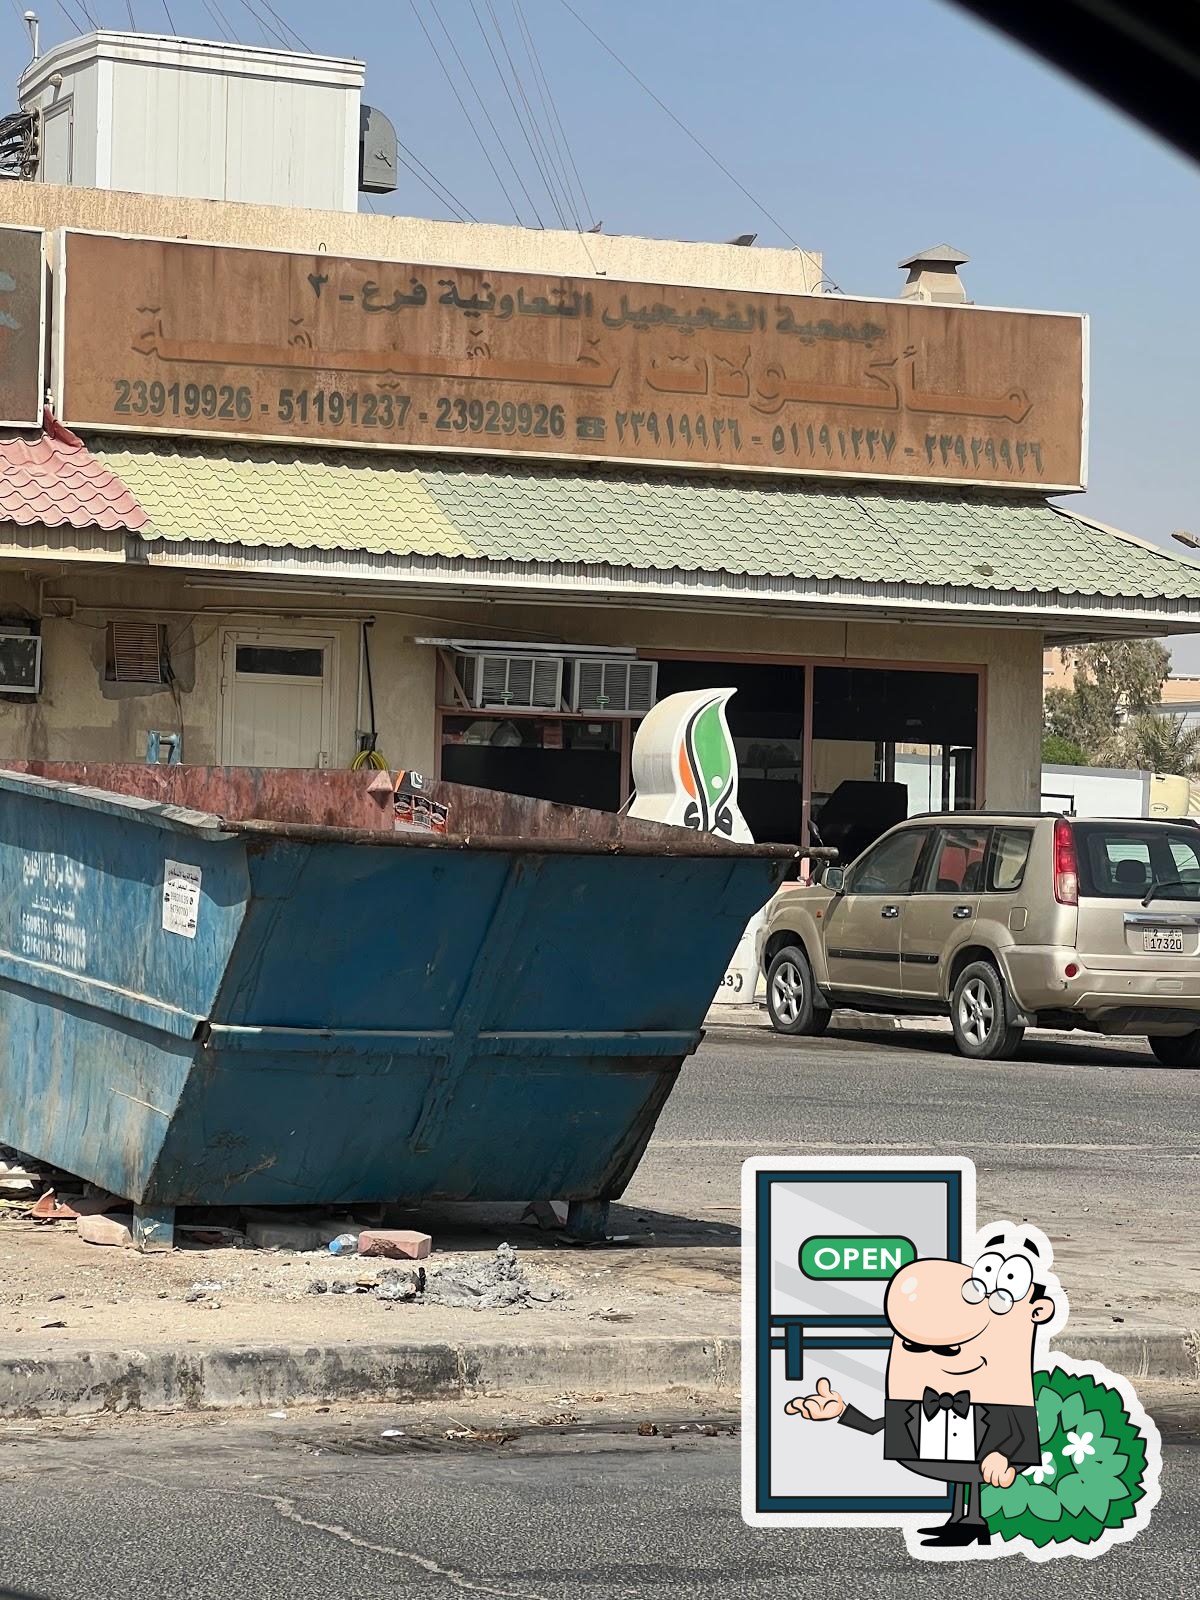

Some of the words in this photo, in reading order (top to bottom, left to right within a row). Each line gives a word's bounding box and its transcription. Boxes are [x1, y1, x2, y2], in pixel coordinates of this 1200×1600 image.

[361, 277, 428, 313] فرع
[437, 279, 594, 320] التعاونية
[776, 304, 886, 348] جمعية
[114, 379, 252, 421] 23919926
[278, 388, 412, 429] 51191237
[436, 398, 566, 438] 23929926
[1150, 938, 1182, 950] 17320
